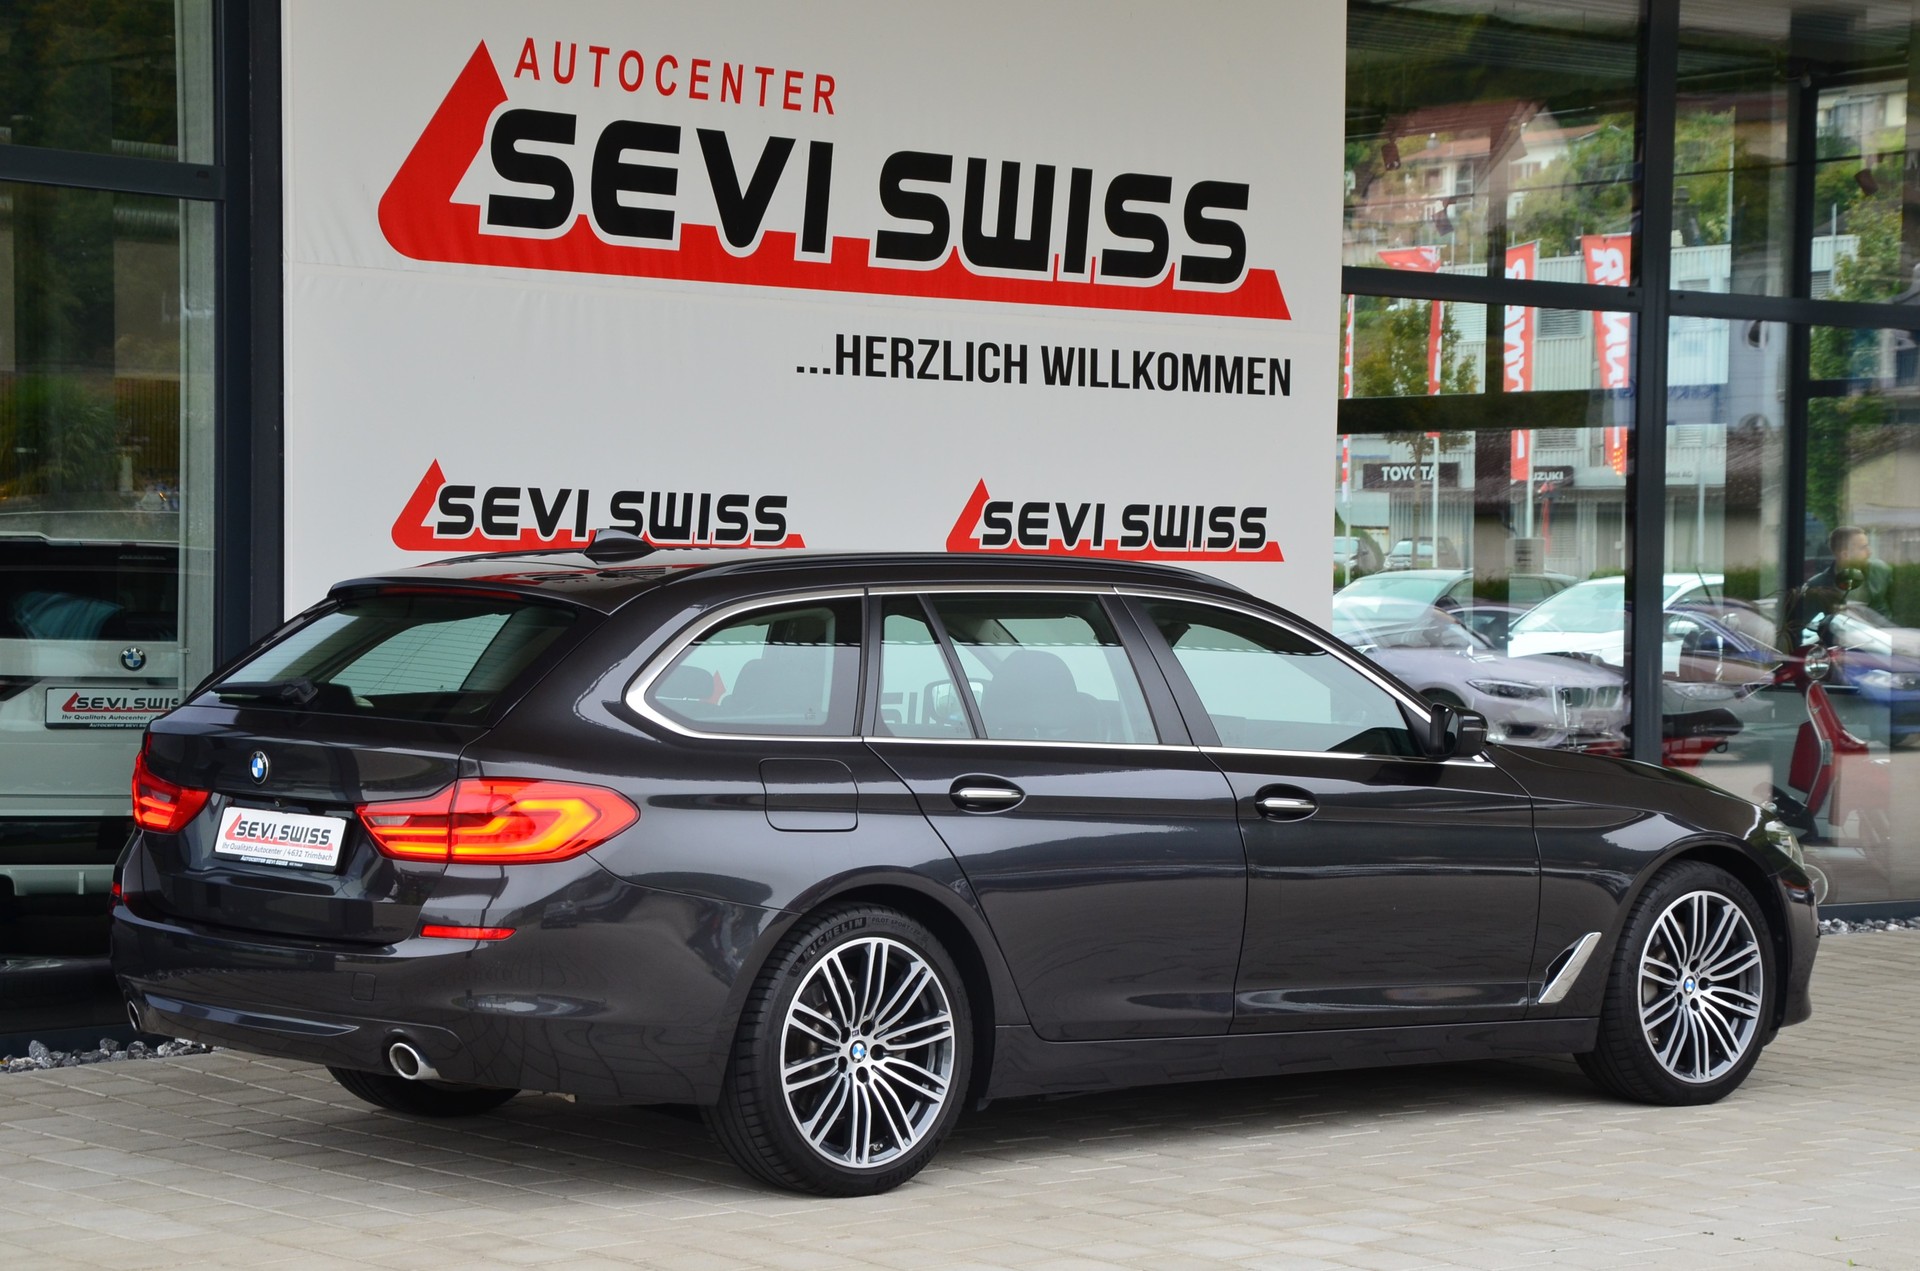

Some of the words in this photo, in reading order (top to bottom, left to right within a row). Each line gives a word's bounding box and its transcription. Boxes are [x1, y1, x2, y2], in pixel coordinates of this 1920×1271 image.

[514, 37, 836, 116] AUTOCENTER
[487, 108, 834, 254] SEVI
[875, 150, 1250, 285] SWISS
[1040, 345, 1291, 397] WILLKOMMEN
[436, 485, 590, 538] SEVI
[609, 490, 788, 542] SWISS
[982, 501, 1105, 547] SEVI
[1120, 504, 1267, 549] SWISS
[76, 697, 127, 709] SEVI
[133, 697, 179, 709] SWIS
[237, 821, 277, 840] SEVI
[279, 825, 331, 845] SWISS
[254, 845, 282, 855] Autocenter
[287, 849, 303, 858] 4632
[304, 851, 333, 861] Trimbach
[804, 918, 863, 960] MICHELIN
